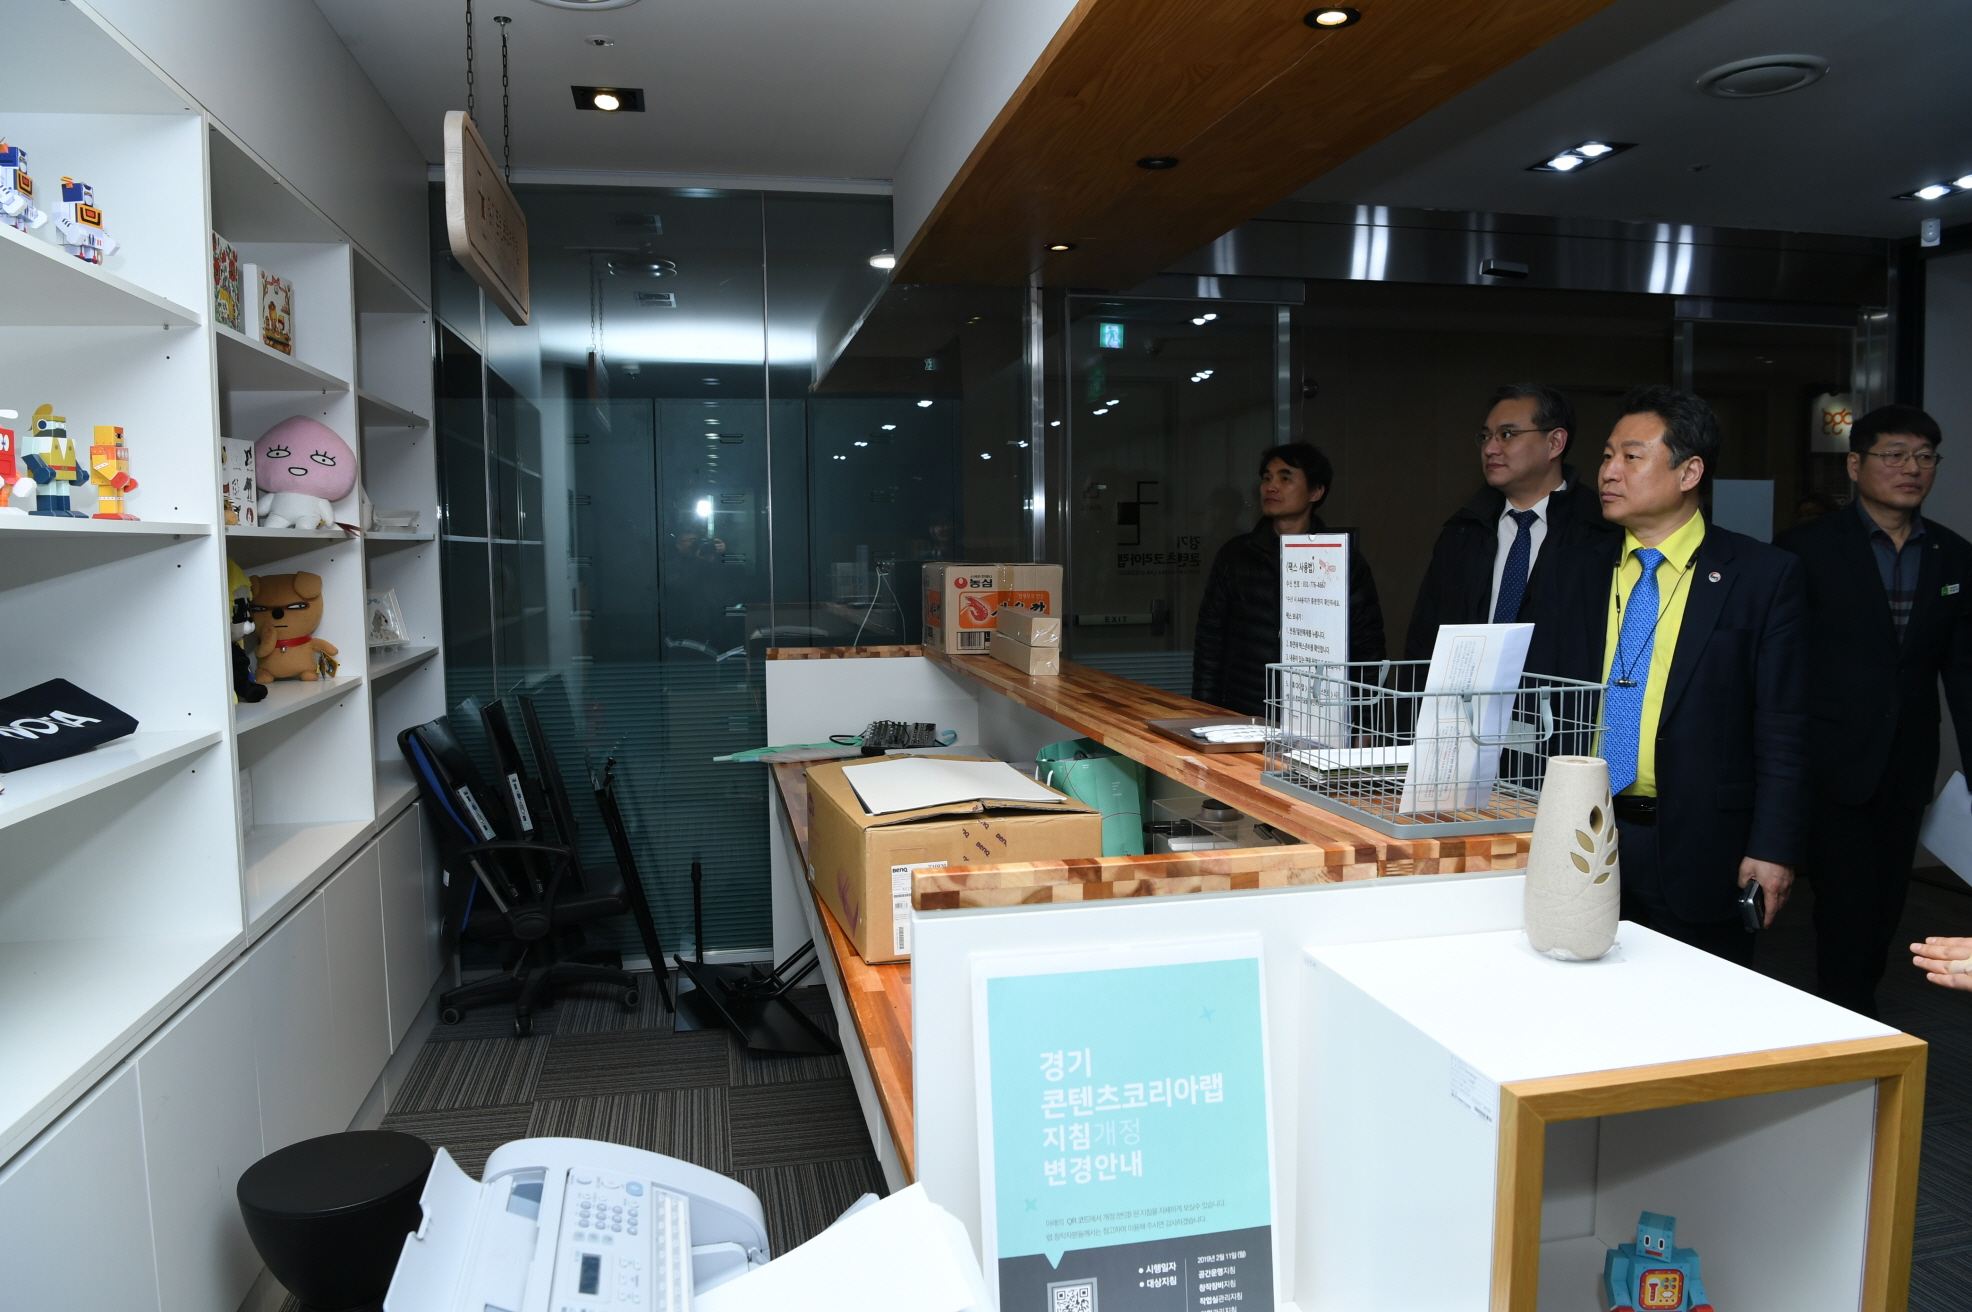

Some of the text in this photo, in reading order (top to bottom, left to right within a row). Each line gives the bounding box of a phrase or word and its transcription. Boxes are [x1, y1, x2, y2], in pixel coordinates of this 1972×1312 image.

[970, 578, 993, 588] 농심
[976, 842, 990, 857] BenQ
[1039, 1047, 1092, 1082] 경기
[1040, 1073, 1224, 1120] 콘텐츠코리아랩
[1044, 1150, 1143, 1187] 변경안내
[1066, 1217, 1077, 1225] QR
[1078, 1214, 1102, 1224] 코드에서
[1197, 1254, 1215, 1264] 2019년
[1216, 1253, 1225, 1261] 2월
[1225, 1251, 1237, 1260] 11일
[1146, 1261, 1177, 1274] 시행일자
[1198, 1266, 1236, 1279] 공간운영지침
[1146, 1276, 1177, 1289] 대상지침
[1199, 1279, 1236, 1292] 창작장비지침
[1199, 1292, 1243, 1306] 작업실관리지침
